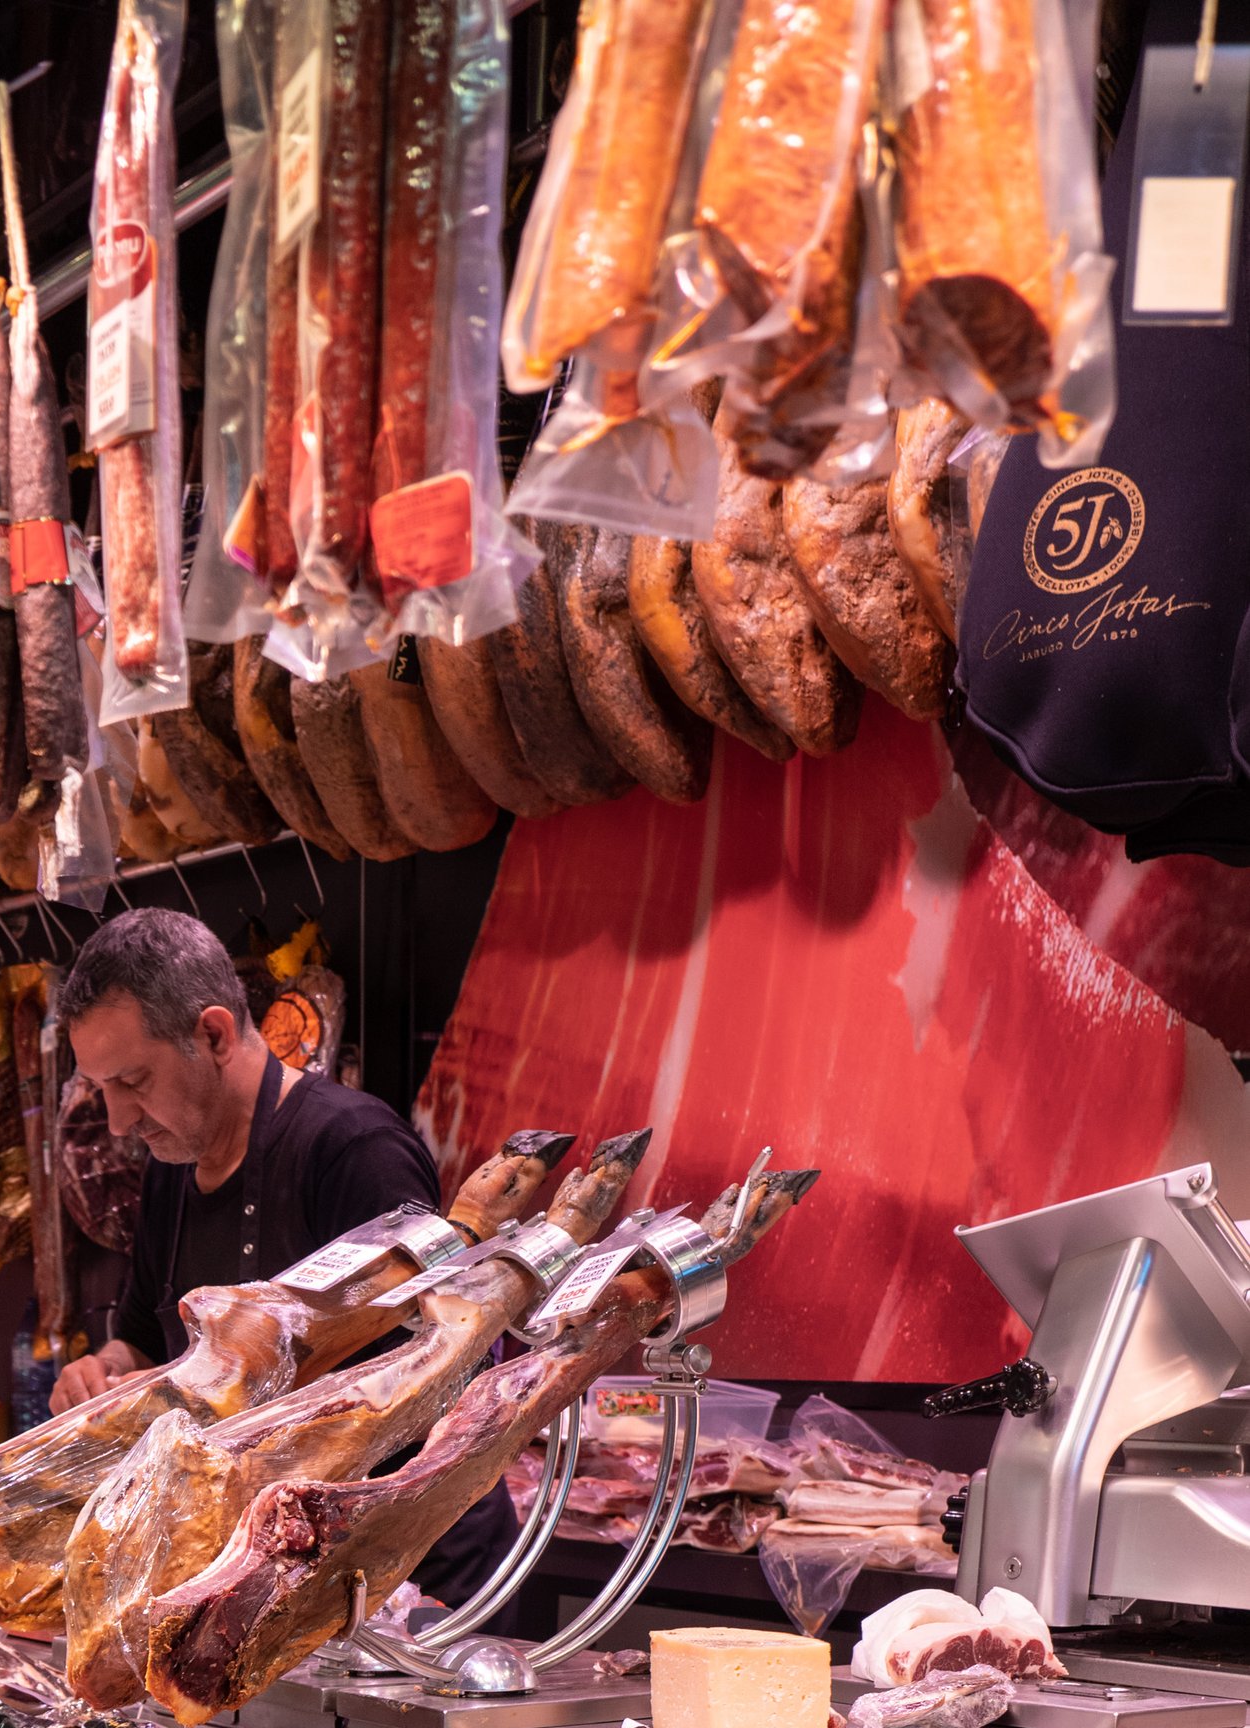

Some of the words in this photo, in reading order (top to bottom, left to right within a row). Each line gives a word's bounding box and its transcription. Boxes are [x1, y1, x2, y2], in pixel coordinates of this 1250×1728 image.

[1045, 474, 1083, 502] CINCO
[1088, 470, 1122, 485] JOTAS
[1047, 492, 1116, 571] 5J
[1103, 544, 1134, 576] 100%
[1038, 575, 1091, 592] BELLOTA
[983, 609, 1070, 660] Cinco
[1072, 583, 1211, 650] Jotas
